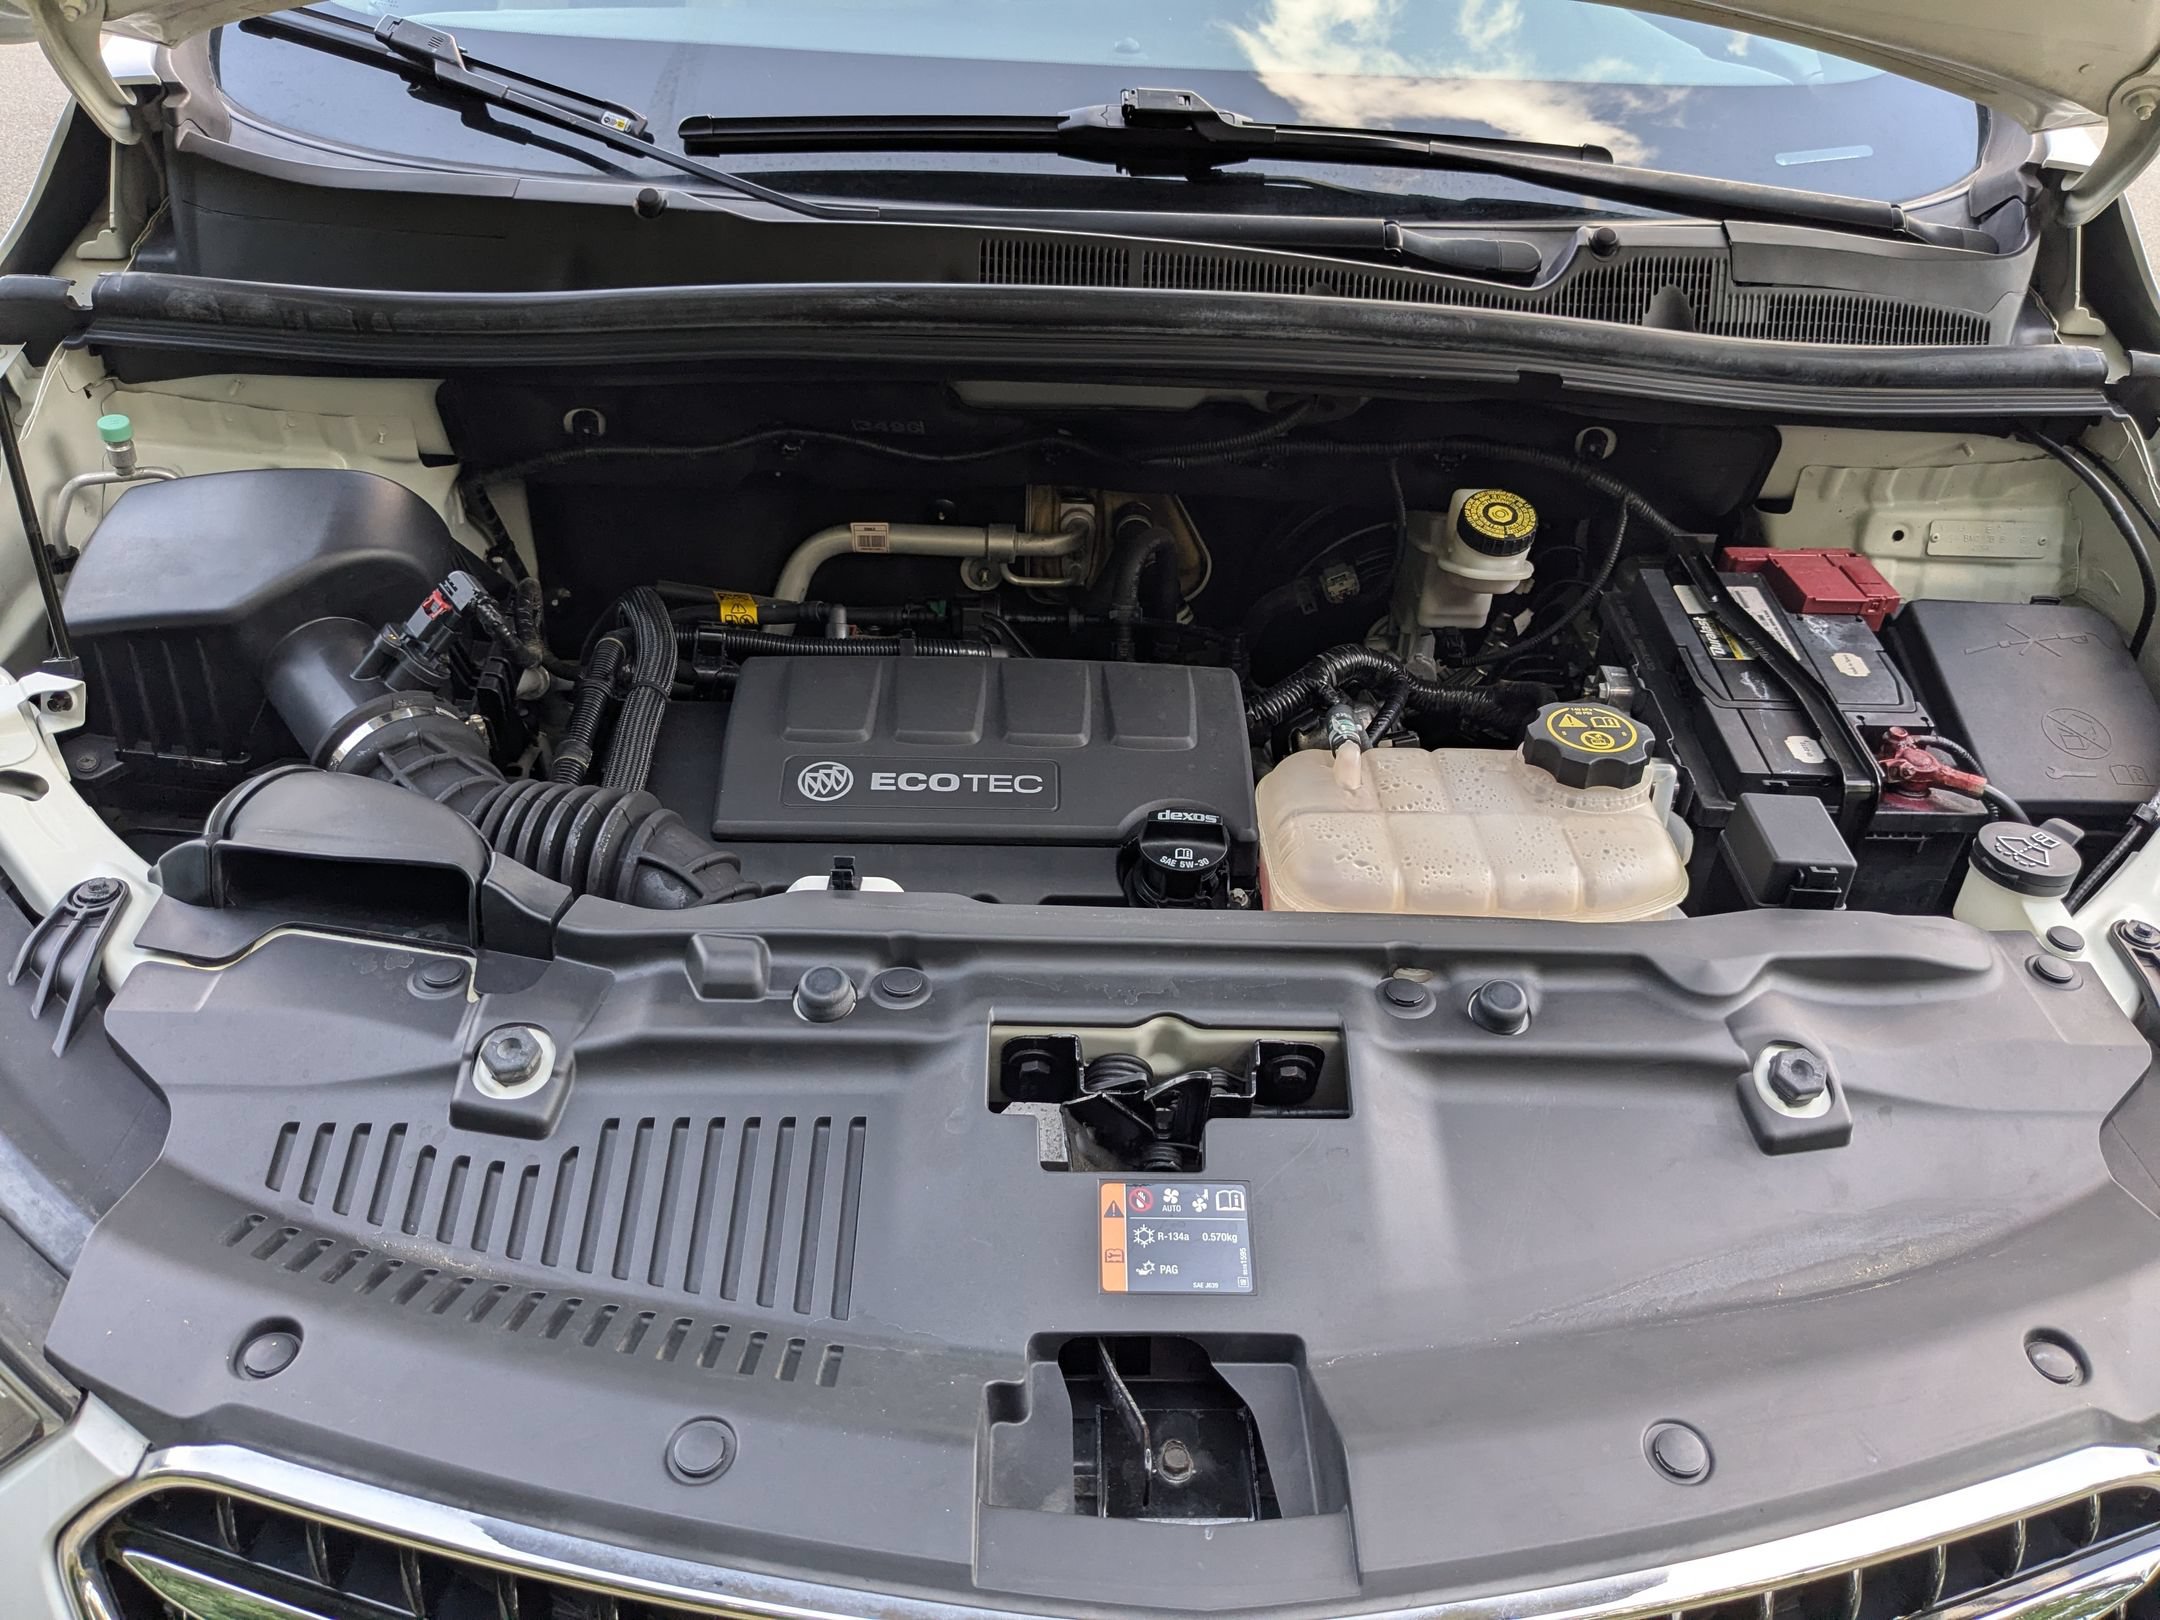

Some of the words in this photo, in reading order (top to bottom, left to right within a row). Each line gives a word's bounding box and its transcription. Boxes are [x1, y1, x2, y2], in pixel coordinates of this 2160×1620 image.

[1692, 616, 1727, 656] Duralast
[870, 772, 1043, 794] ECOTEC
[1157, 809, 1220, 824] dexos
[1160, 855, 1177, 867] SAE
[1180, 857, 1210, 869] 5W-30
[1162, 1204, 1182, 1212] AUTO
[1157, 1231, 1190, 1241] R-134a
[1202, 1232, 1238, 1243] 0.570kg
[1159, 1264, 1179, 1275] PAG
